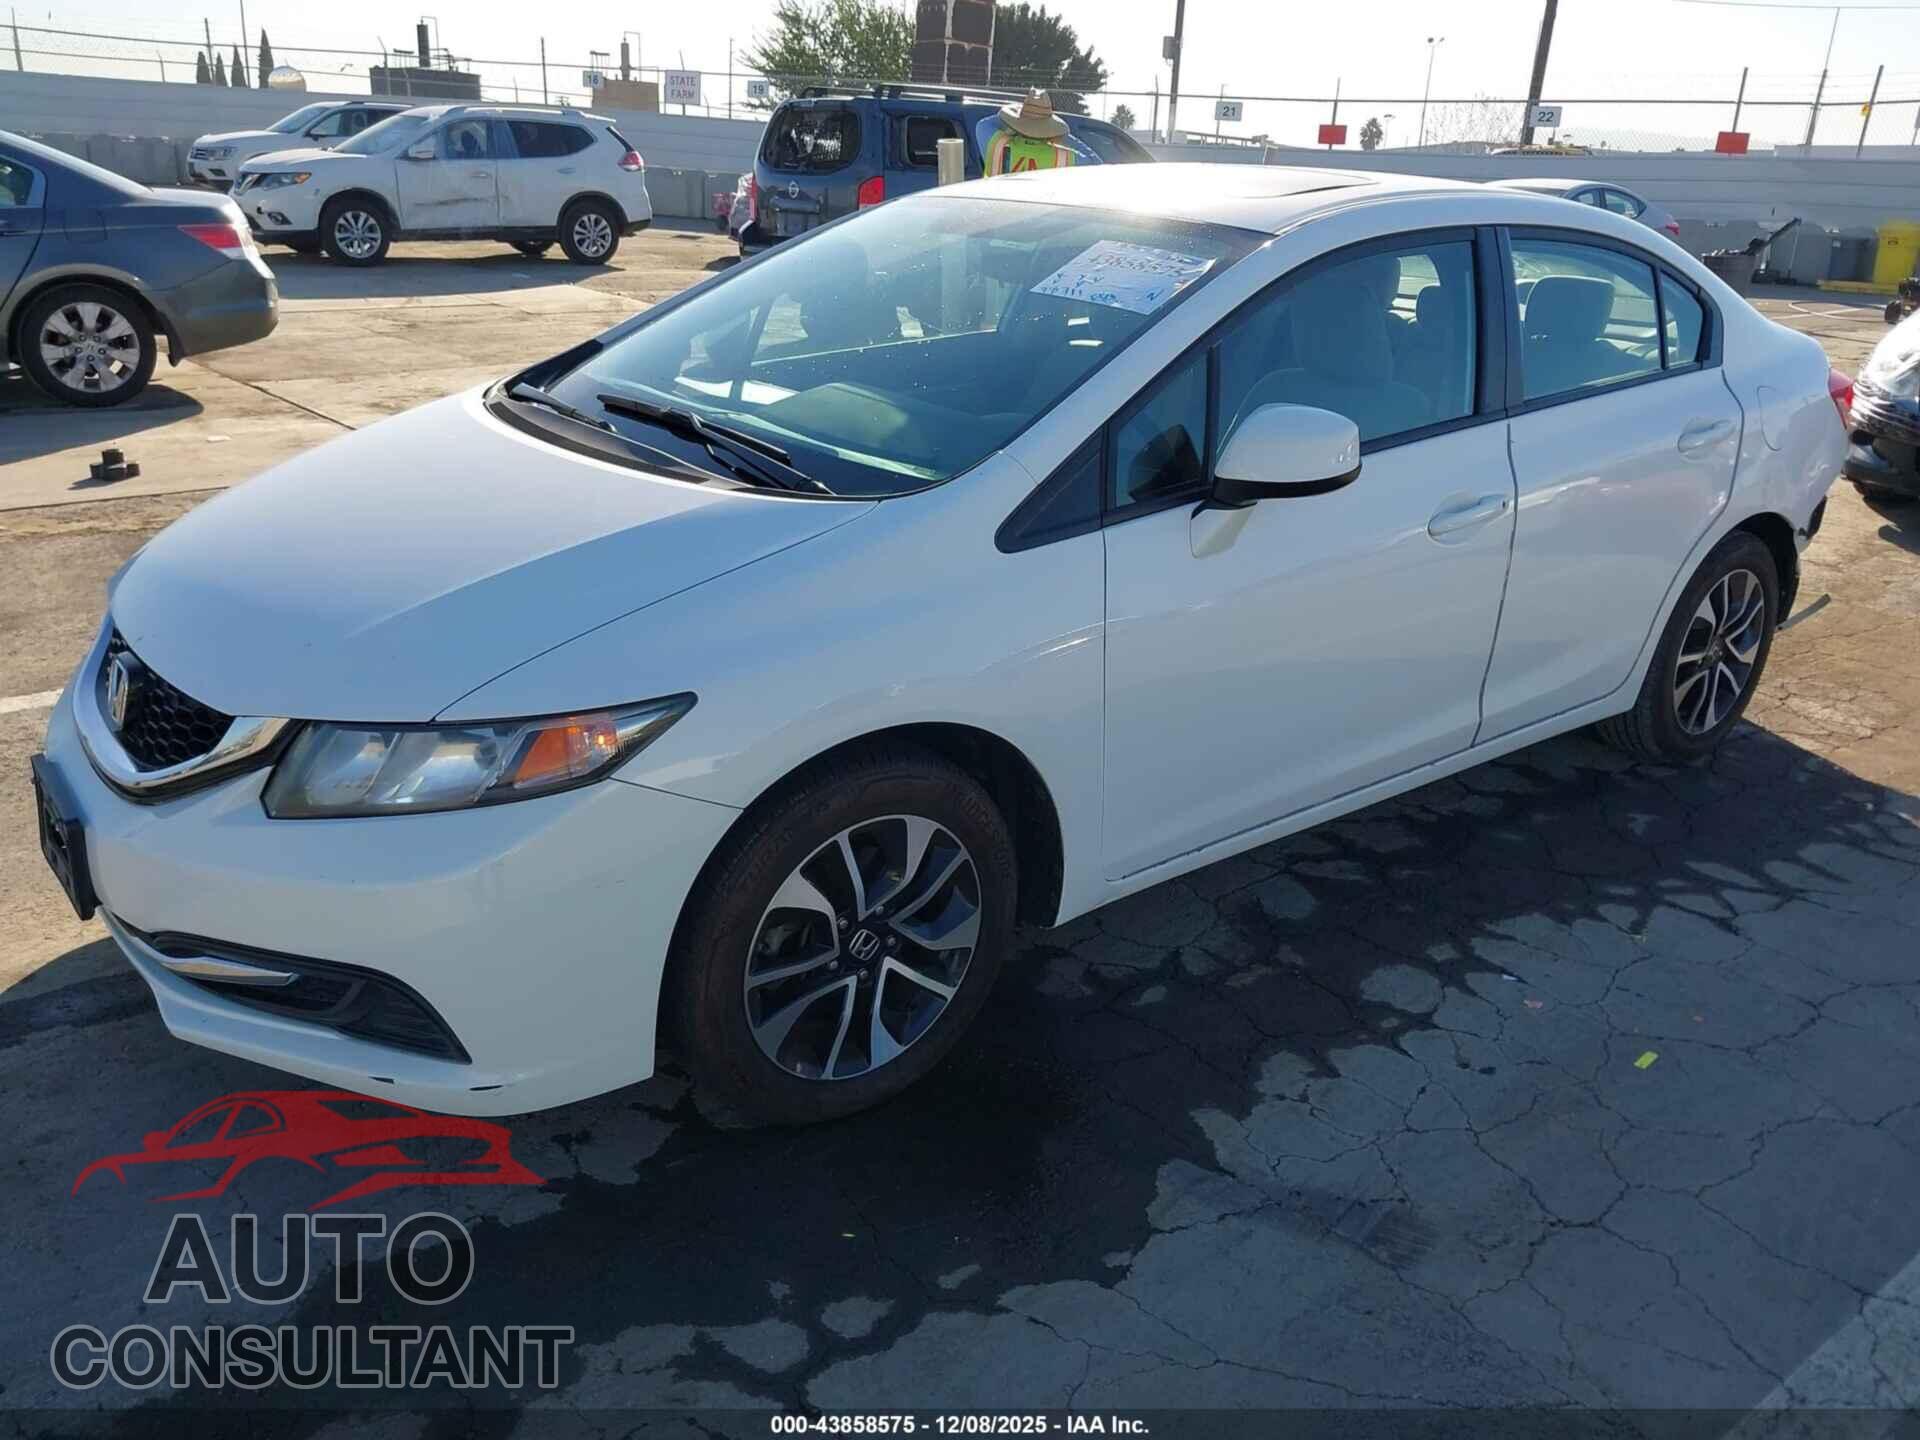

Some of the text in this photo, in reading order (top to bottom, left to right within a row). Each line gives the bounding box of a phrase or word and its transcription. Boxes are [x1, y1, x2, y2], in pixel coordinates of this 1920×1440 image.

[670, 76, 696, 87] STATE
[671, 88, 695, 98] FARM
[752, 85, 765, 95] 19
[1222, 105, 1236, 117] 21
[1537, 111, 1554, 122] 22
